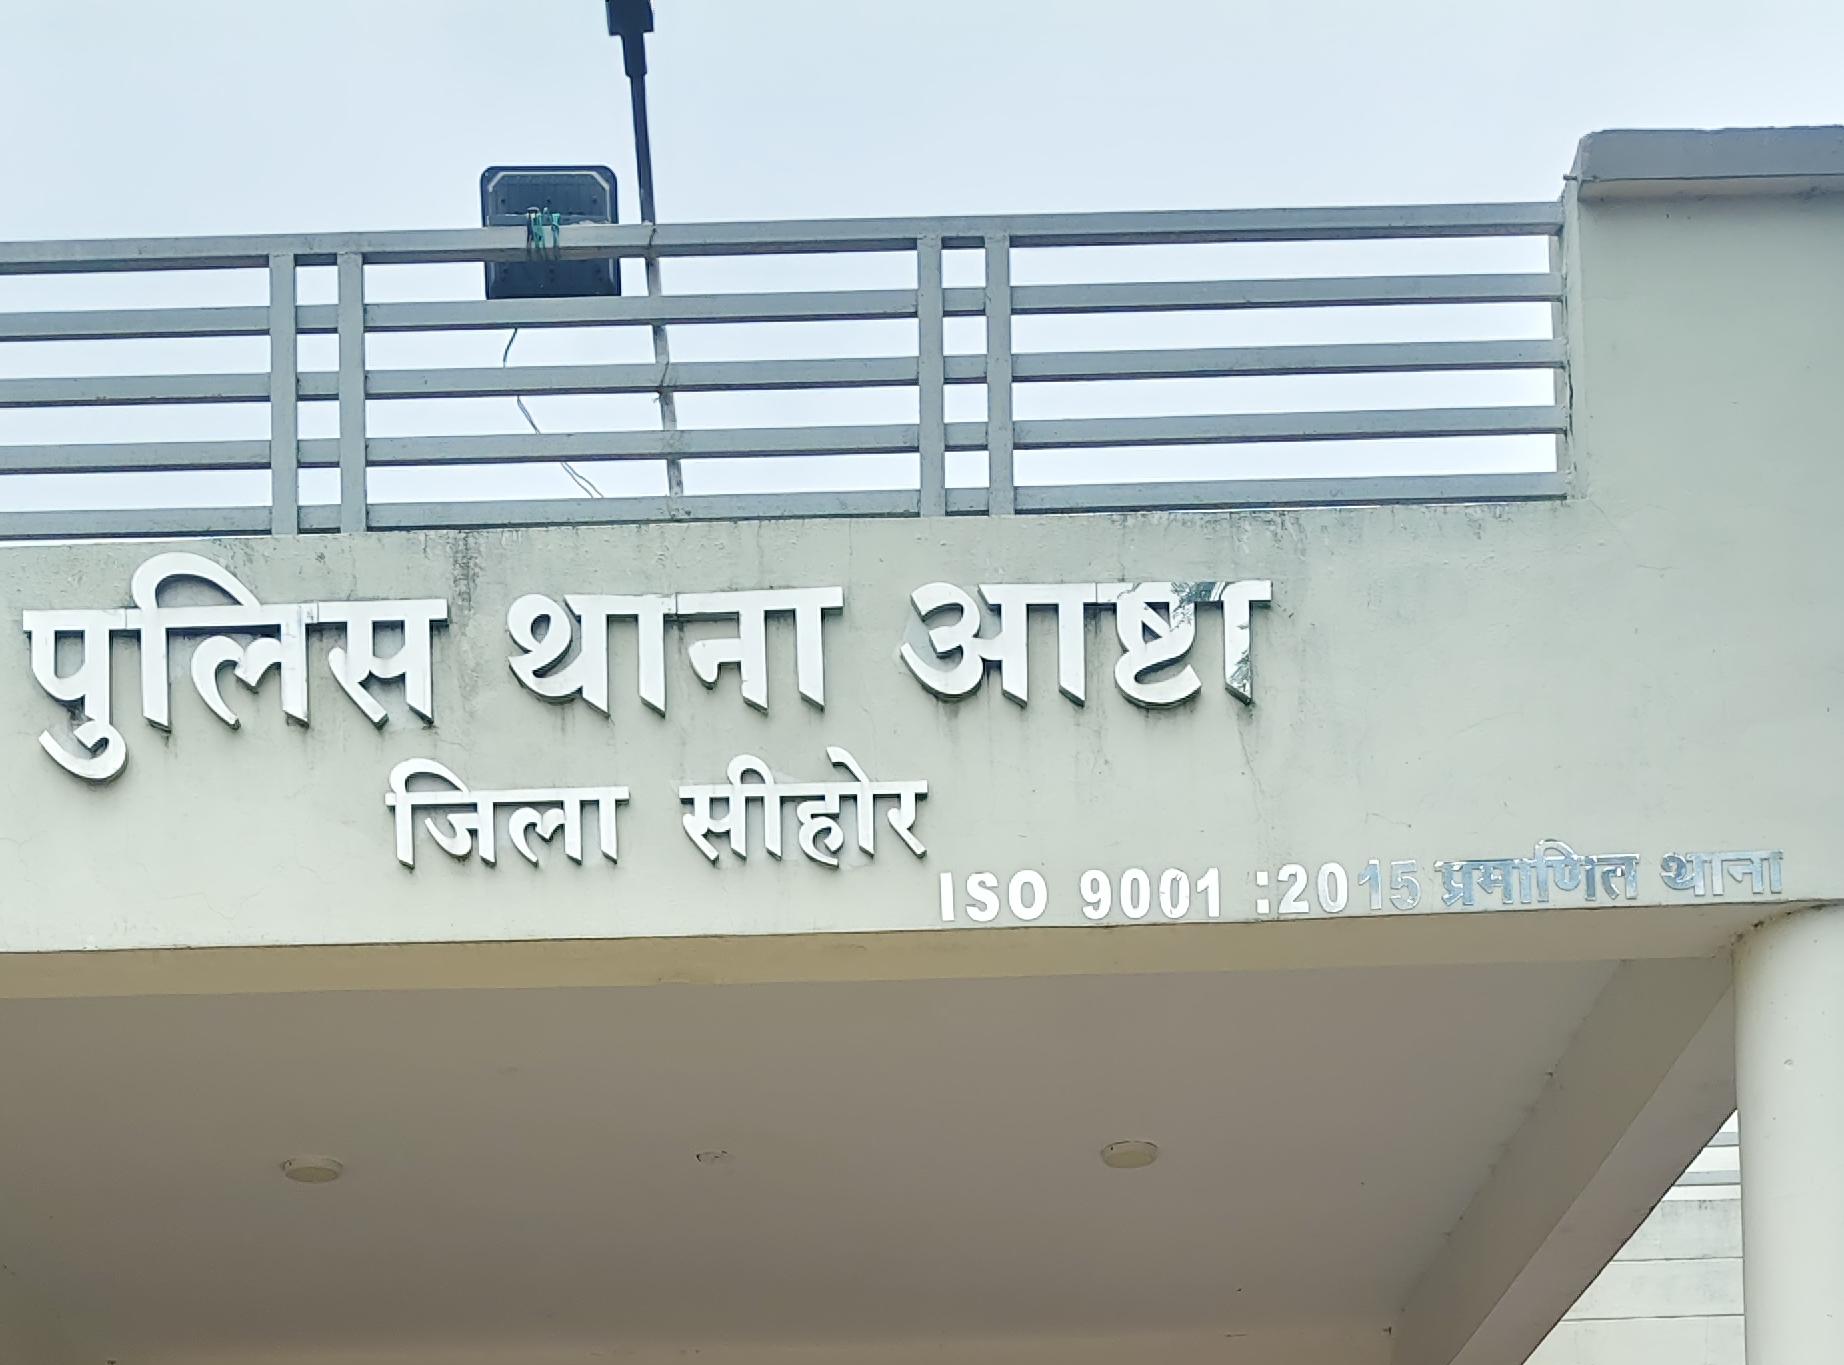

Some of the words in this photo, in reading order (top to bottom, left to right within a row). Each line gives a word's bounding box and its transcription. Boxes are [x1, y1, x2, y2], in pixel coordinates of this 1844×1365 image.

[23, 551, 449, 782] पुलिस
[506, 586, 843, 717] थाना
[900, 579, 1271, 709] आष्टा
[384, 757, 630, 869] जिला
[679, 746, 928, 867] सीहोर
[939, 869, 1048, 922] ISO
[1080, 866, 1222, 920] 9001
[1434, 838, 1640, 907] प्रमाणित
[1660, 848, 1784, 897] थाना
